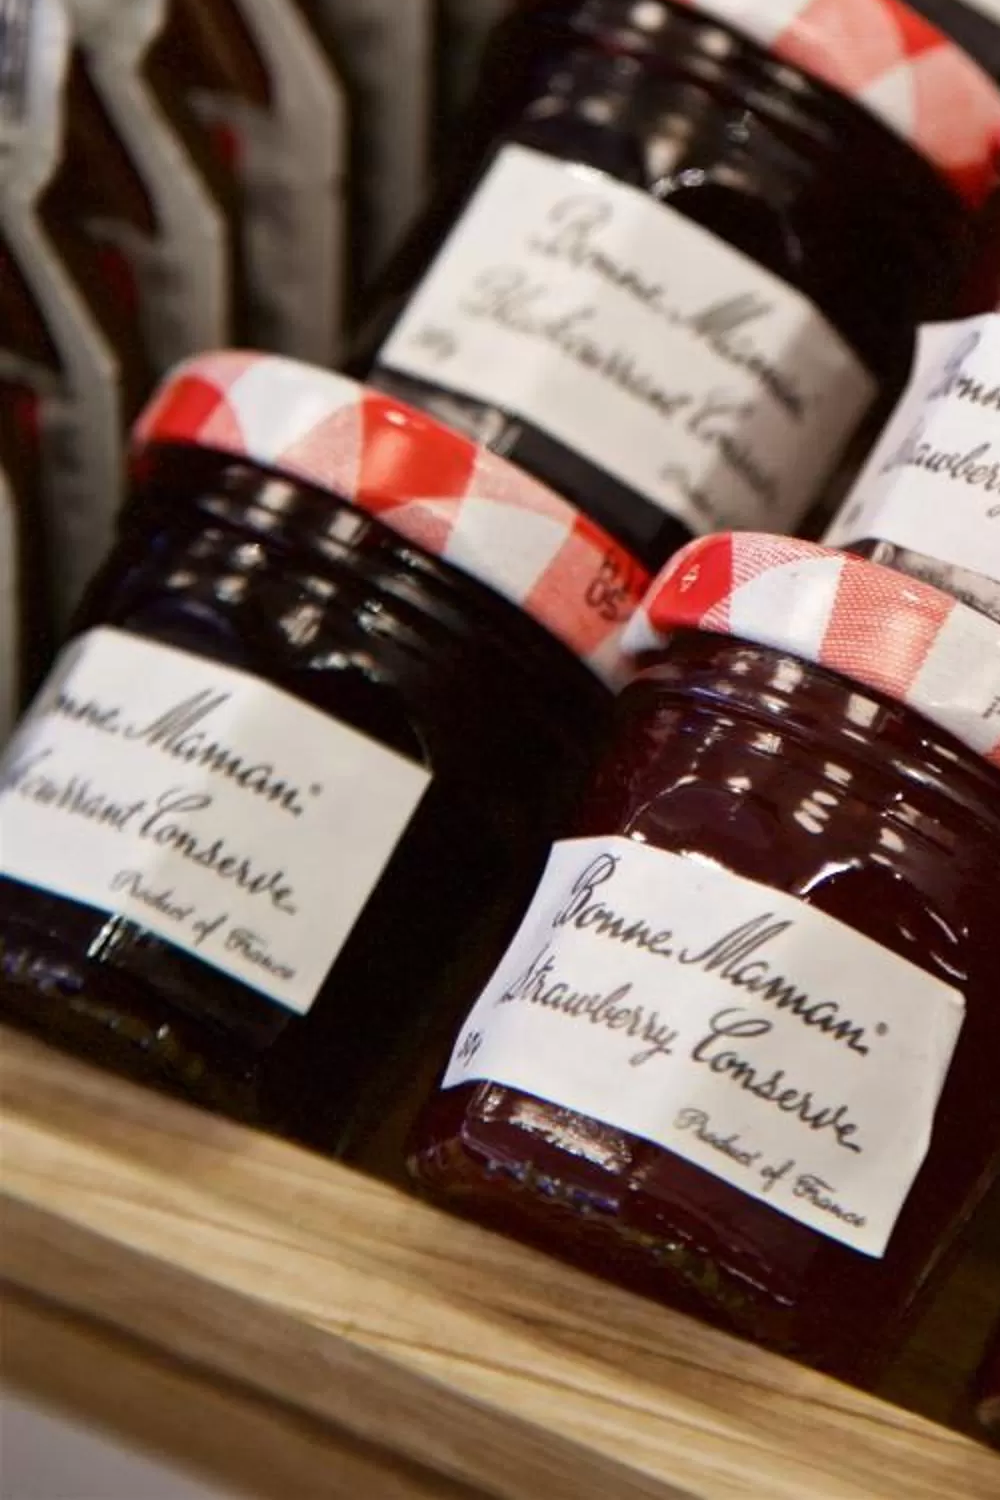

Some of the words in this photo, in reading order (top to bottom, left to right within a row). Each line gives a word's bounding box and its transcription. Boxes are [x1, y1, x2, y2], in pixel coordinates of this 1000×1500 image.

[123, 687, 305, 818] Maman
[138, 786, 298, 917] Conserve
[191, 912, 230, 948] of
[552, 852, 675, 959] Bonne
[678, 910, 870, 1058] Maman
[496, 942, 680, 1068] Strawberry
[689, 1005, 863, 1154] Conserve
[673, 1106, 754, 1169] Product
[758, 1159, 791, 1188] of
[792, 1172, 867, 1230] France
